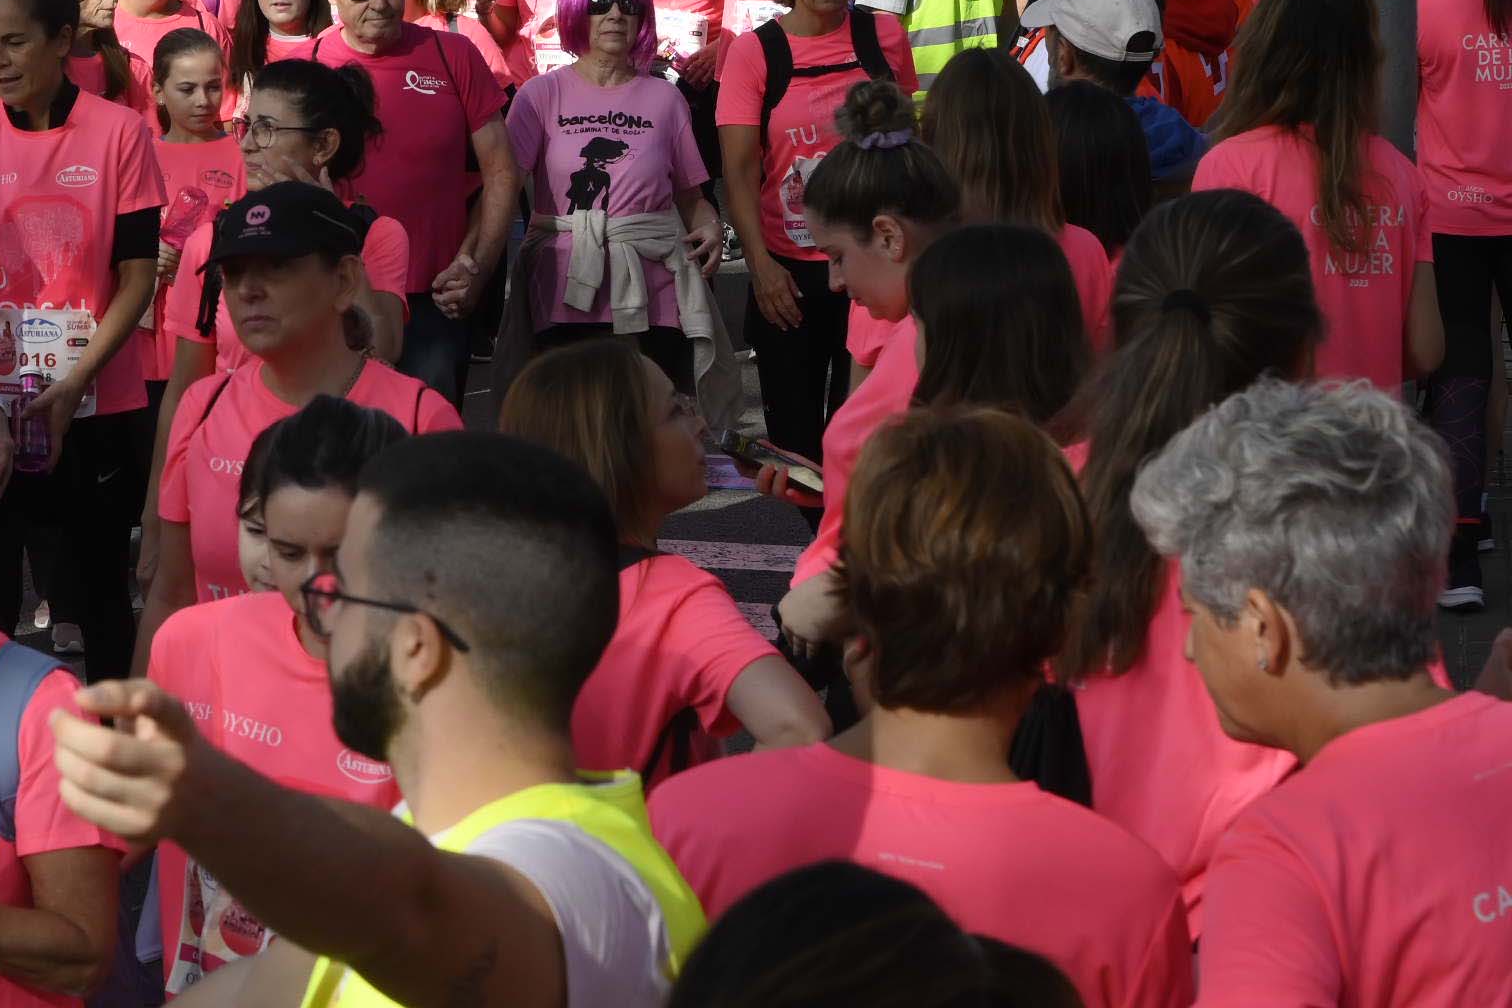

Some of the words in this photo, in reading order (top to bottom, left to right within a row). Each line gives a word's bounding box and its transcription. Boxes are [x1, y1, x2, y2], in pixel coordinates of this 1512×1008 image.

[1478, 50, 1502, 65] DE
[785, 124, 818, 147] TU
[58, 173, 98, 183] ASTURIANA
[1447, 189, 1495, 204] OYSHO
[17, 326, 60, 338] ASTURIANA
[19, 352, 57, 368] 016
[223, 710, 282, 748] YSHO
